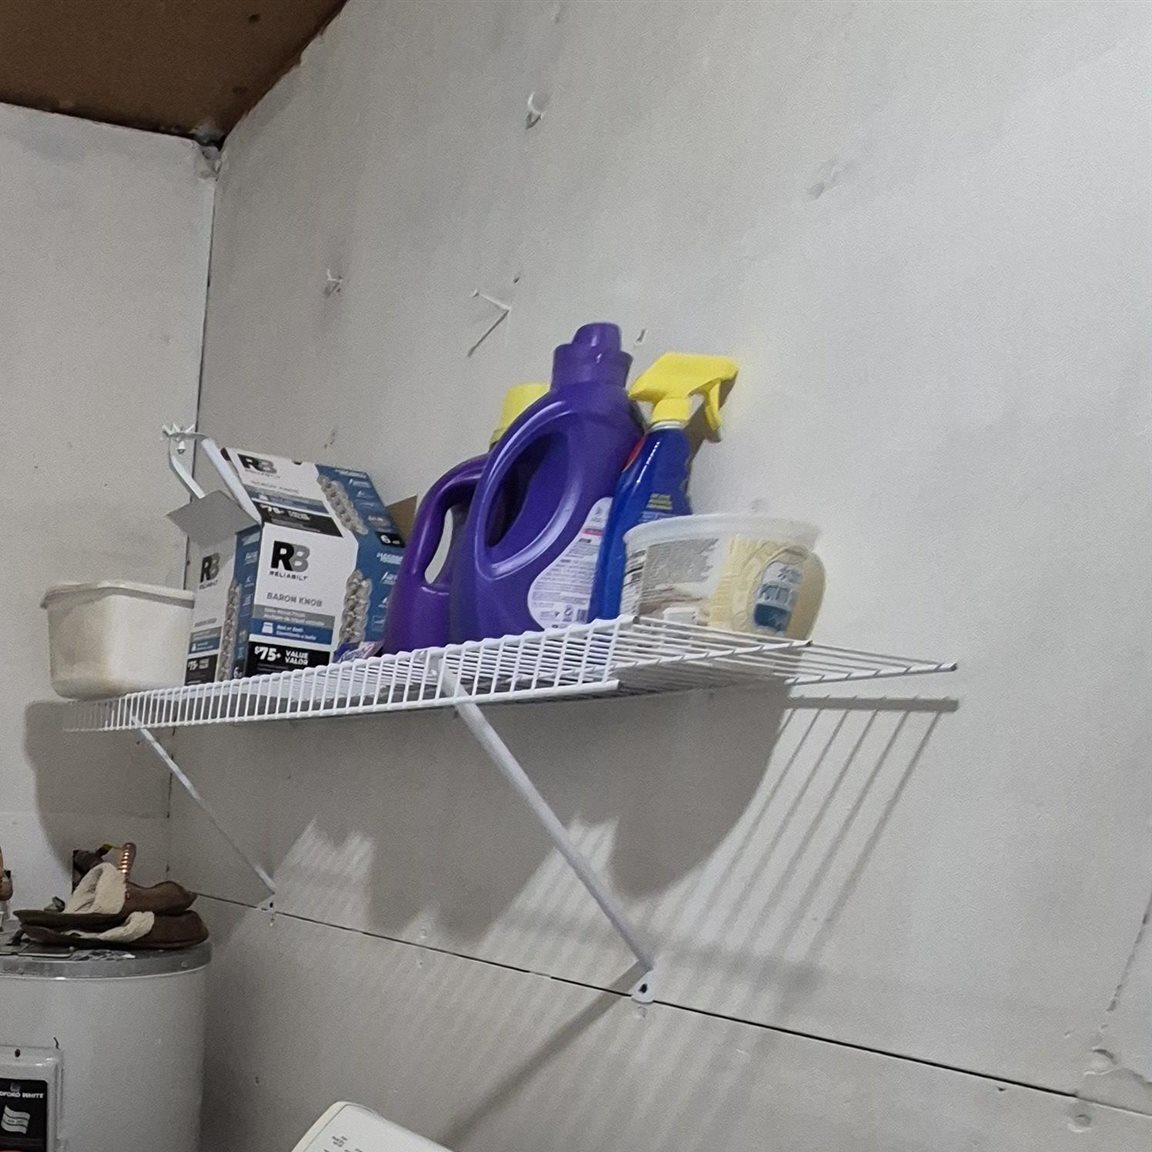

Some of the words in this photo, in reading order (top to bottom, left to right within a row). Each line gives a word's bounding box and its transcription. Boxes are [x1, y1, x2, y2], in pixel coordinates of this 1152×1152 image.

[271, 540, 310, 572] RB
[267, 592, 296, 603] BARON
[299, 597, 322, 607] KNOB
[254, 646, 281, 661] $75+
[285, 650, 308, 658] VALUE
[285, 657, 308, 665] VALOR
